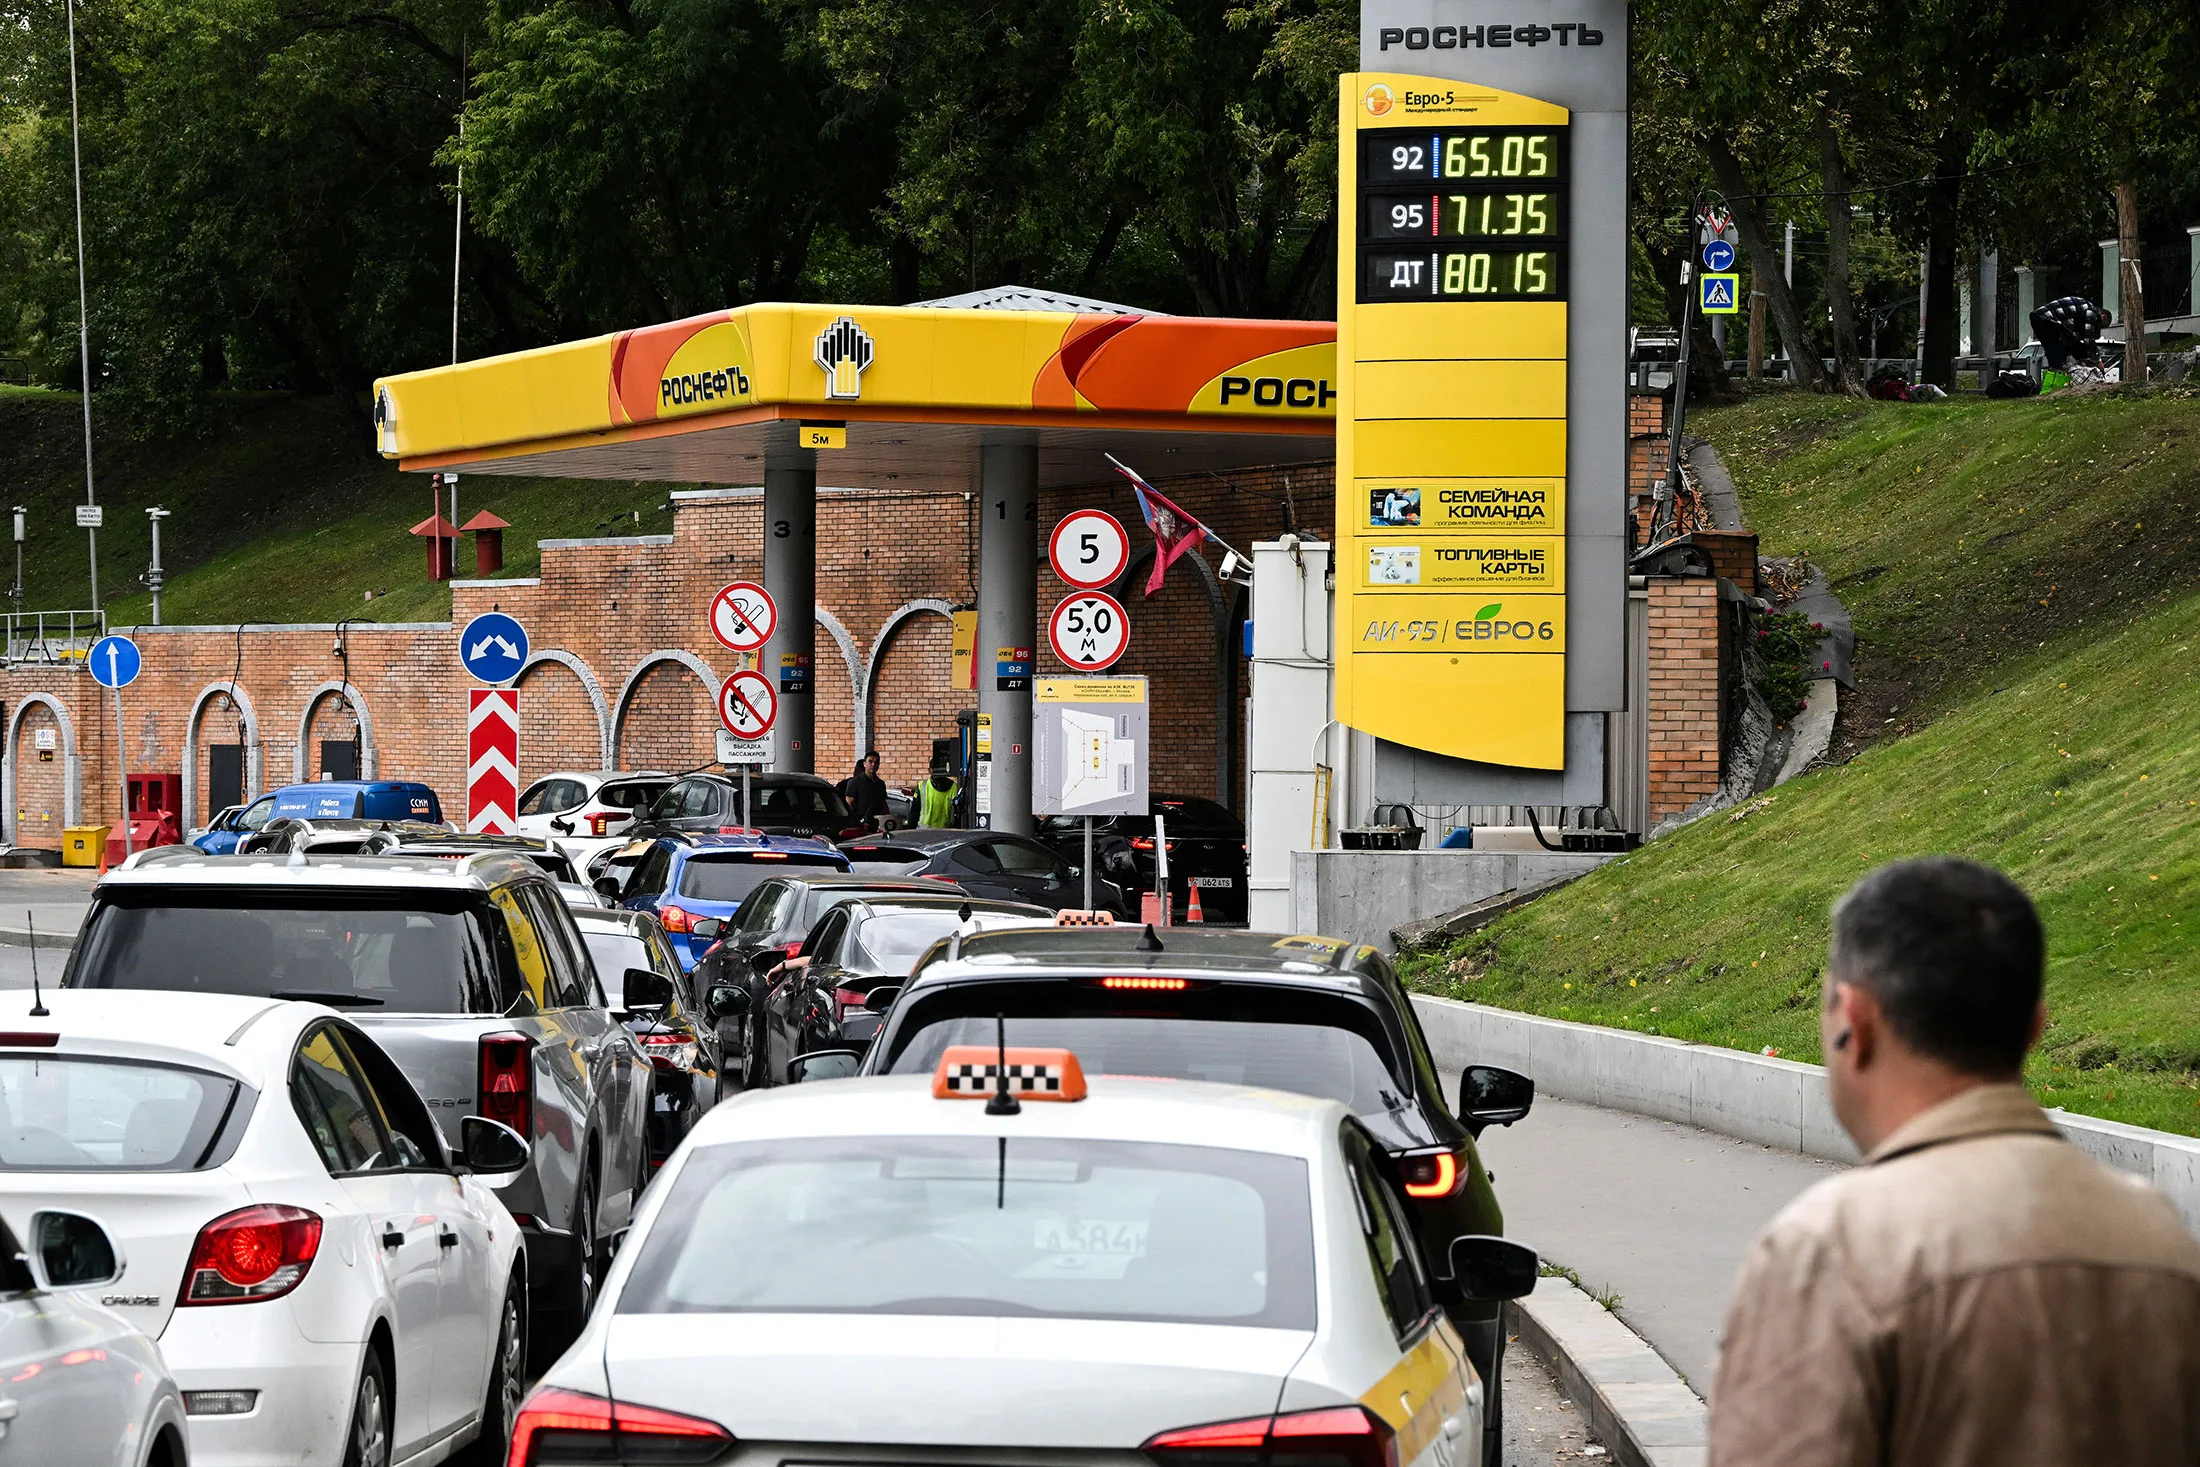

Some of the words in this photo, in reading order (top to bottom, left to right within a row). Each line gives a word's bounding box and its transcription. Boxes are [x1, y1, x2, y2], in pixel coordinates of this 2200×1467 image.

[1380, 23, 1604, 50] РОСНЕФТЬ
[1392, 146, 1424, 170] 92
[1444, 136, 1548, 177] 65.05
[1391, 204, 1424, 228] 95
[1448, 194, 1547, 235] 71.35
[1390, 260, 1424, 288] ДТ
[1443, 253, 1547, 294] 80.15
[661, 366, 749, 407] РОСНЕФТЬ
[1439, 488, 1545, 503] СЕМЕЙНАЯ
[996, 500, 1006, 520] 1
[1448, 505, 1545, 520] КОМАНДА
[774, 520, 791, 538] 3
[1079, 534, 1100, 564] 5
[1434, 549, 1545, 561] ТОПЛИВНЫЕ
[1481, 562, 1545, 574] КАРТЫ
[1067, 607, 1112, 637] 5,0
[1016, 650, 1029, 658] 95
[790, 669, 803, 677] 92
[1008, 665, 1022, 673] 92
[1007, 680, 1022, 688] ДТ
[320, 799, 340, 807] Работа
[1202, 878, 1216, 886] 062
[101, 1294, 160, 1306] CRUZE
